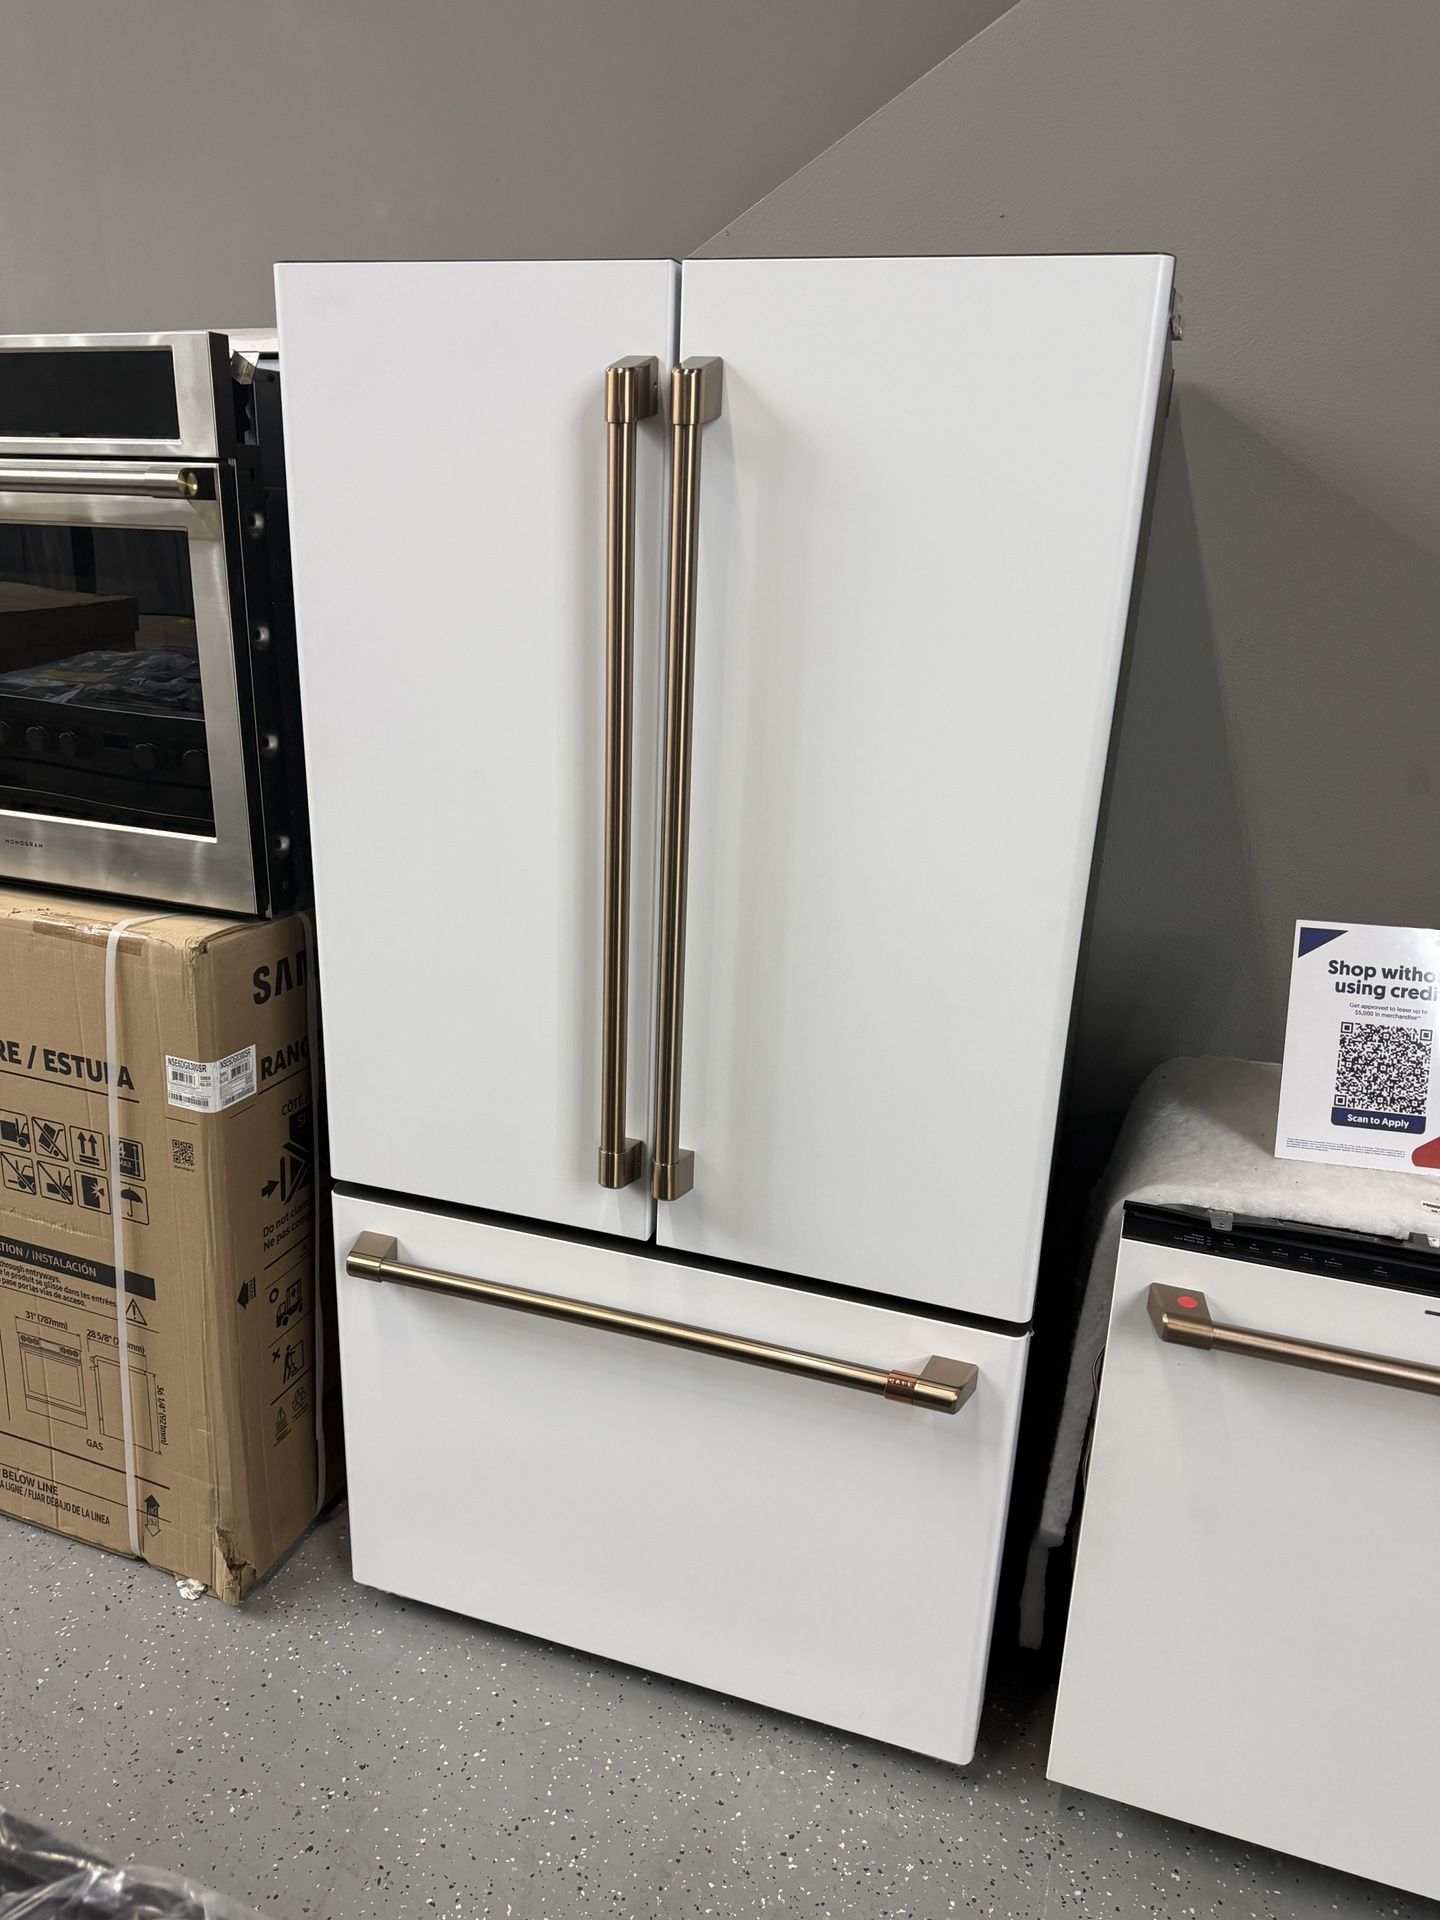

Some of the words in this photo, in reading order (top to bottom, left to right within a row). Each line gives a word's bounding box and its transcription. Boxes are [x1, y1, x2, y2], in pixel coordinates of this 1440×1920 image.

[5, 839, 44, 848] MONOGRAM
[1328, 960, 1377, 980] Shop
[1335, 980, 1386, 1000] using
[1390, 986, 1440, 1001] credi
[1361, 1004, 1388, 1012] approved
[1347, 1113, 1367, 1124] Scan
[1370, 1116, 1381, 1124] to
[1382, 1119, 1410, 1130] Apply
[263, 1222, 275, 1238] Do
[276, 1212, 289, 1229] not
[263, 1238, 275, 1252] Ne
[276, 1227, 290, 1245] pas
[0, 1242, 23, 1257] TION
[32, 1250, 97, 1277] INSTALACIÓN
[25, 1269, 61, 1284] entryways.
[63, 1286, 80, 1296] dans
[81, 1290, 91, 1299] les
[86, 1438, 104, 1451] GAS
[2, 1468, 35, 1488] BELOW
[37, 1480, 58, 1496] LINE
[46, 1496, 71, 1512] DEBAJO
[71, 1504, 81, 1516] DE
[81, 1507, 90, 1519] LA
[90, 1510, 110, 1526] LINEA
